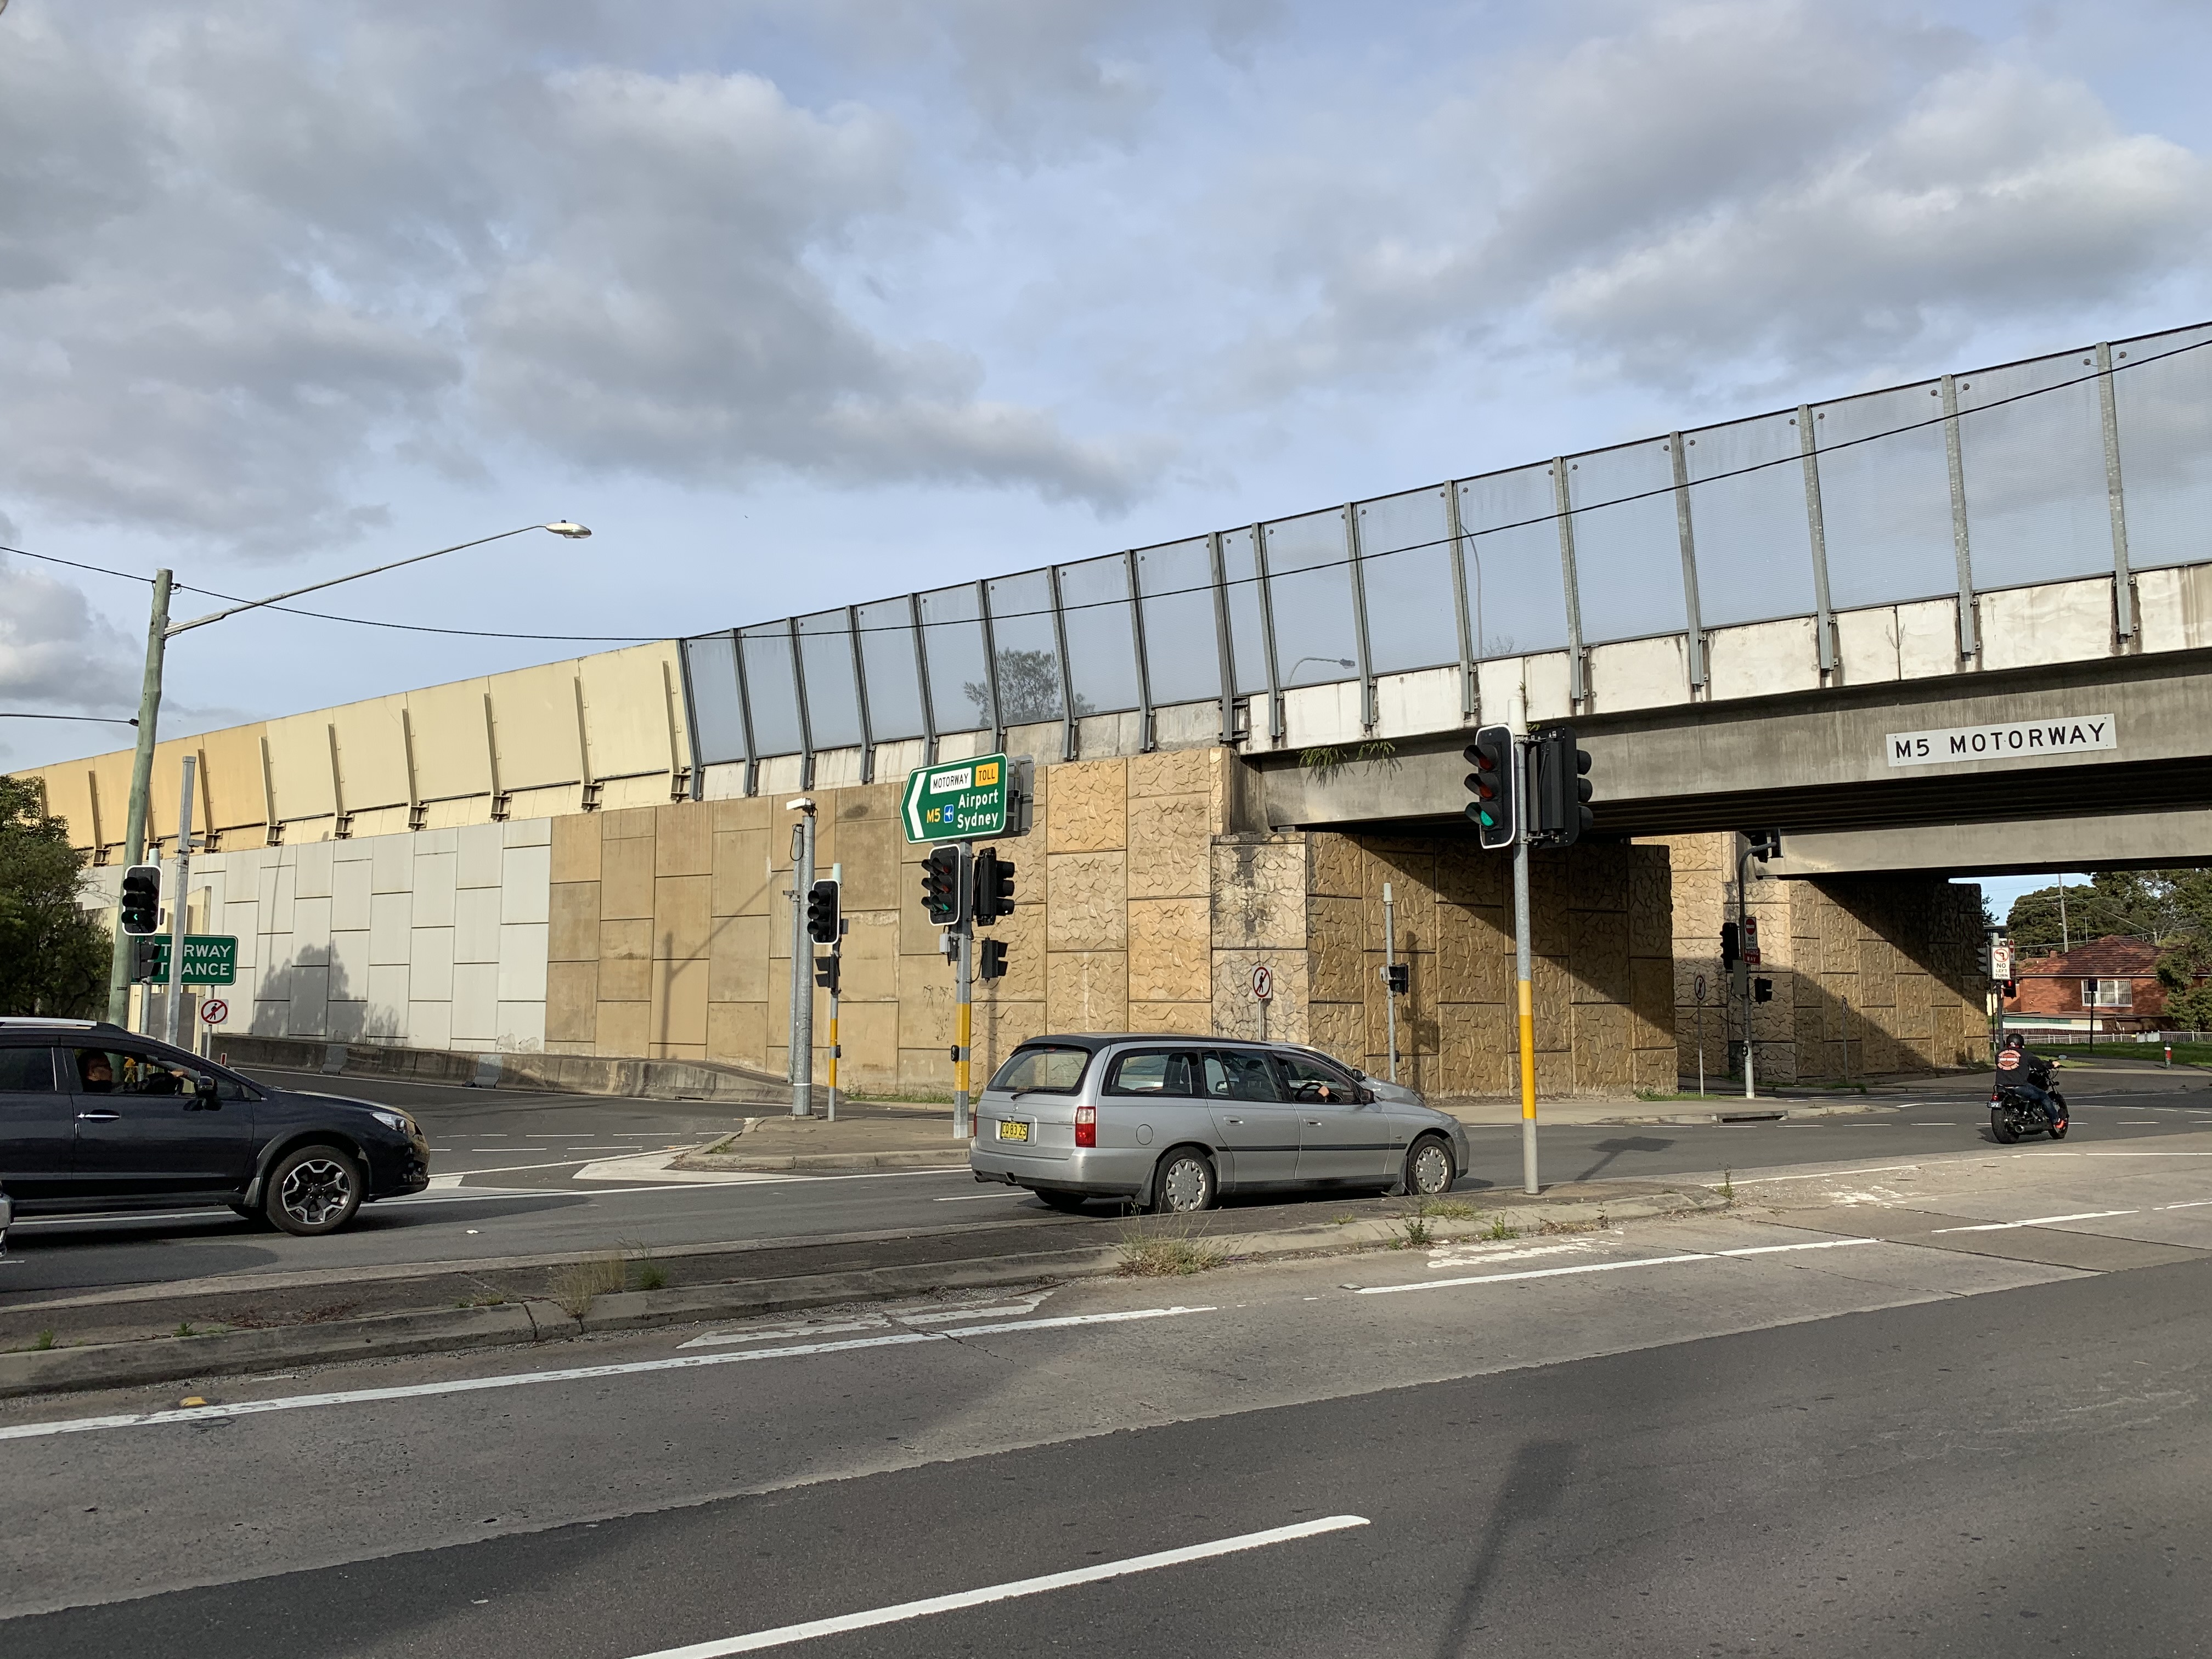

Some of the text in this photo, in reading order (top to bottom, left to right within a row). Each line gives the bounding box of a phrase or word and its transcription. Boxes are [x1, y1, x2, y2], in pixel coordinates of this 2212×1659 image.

[1895, 723, 2104, 758] M5 MOTORWAY
[933, 770, 995, 789] MOTORWAY TOLL
[958, 788, 998, 809] Airport
[926, 808, 941, 823] M5
[957, 812, 998, 831] Sydney
[154, 944, 232, 957] TRWAY
[160, 962, 230, 975] TANCE
